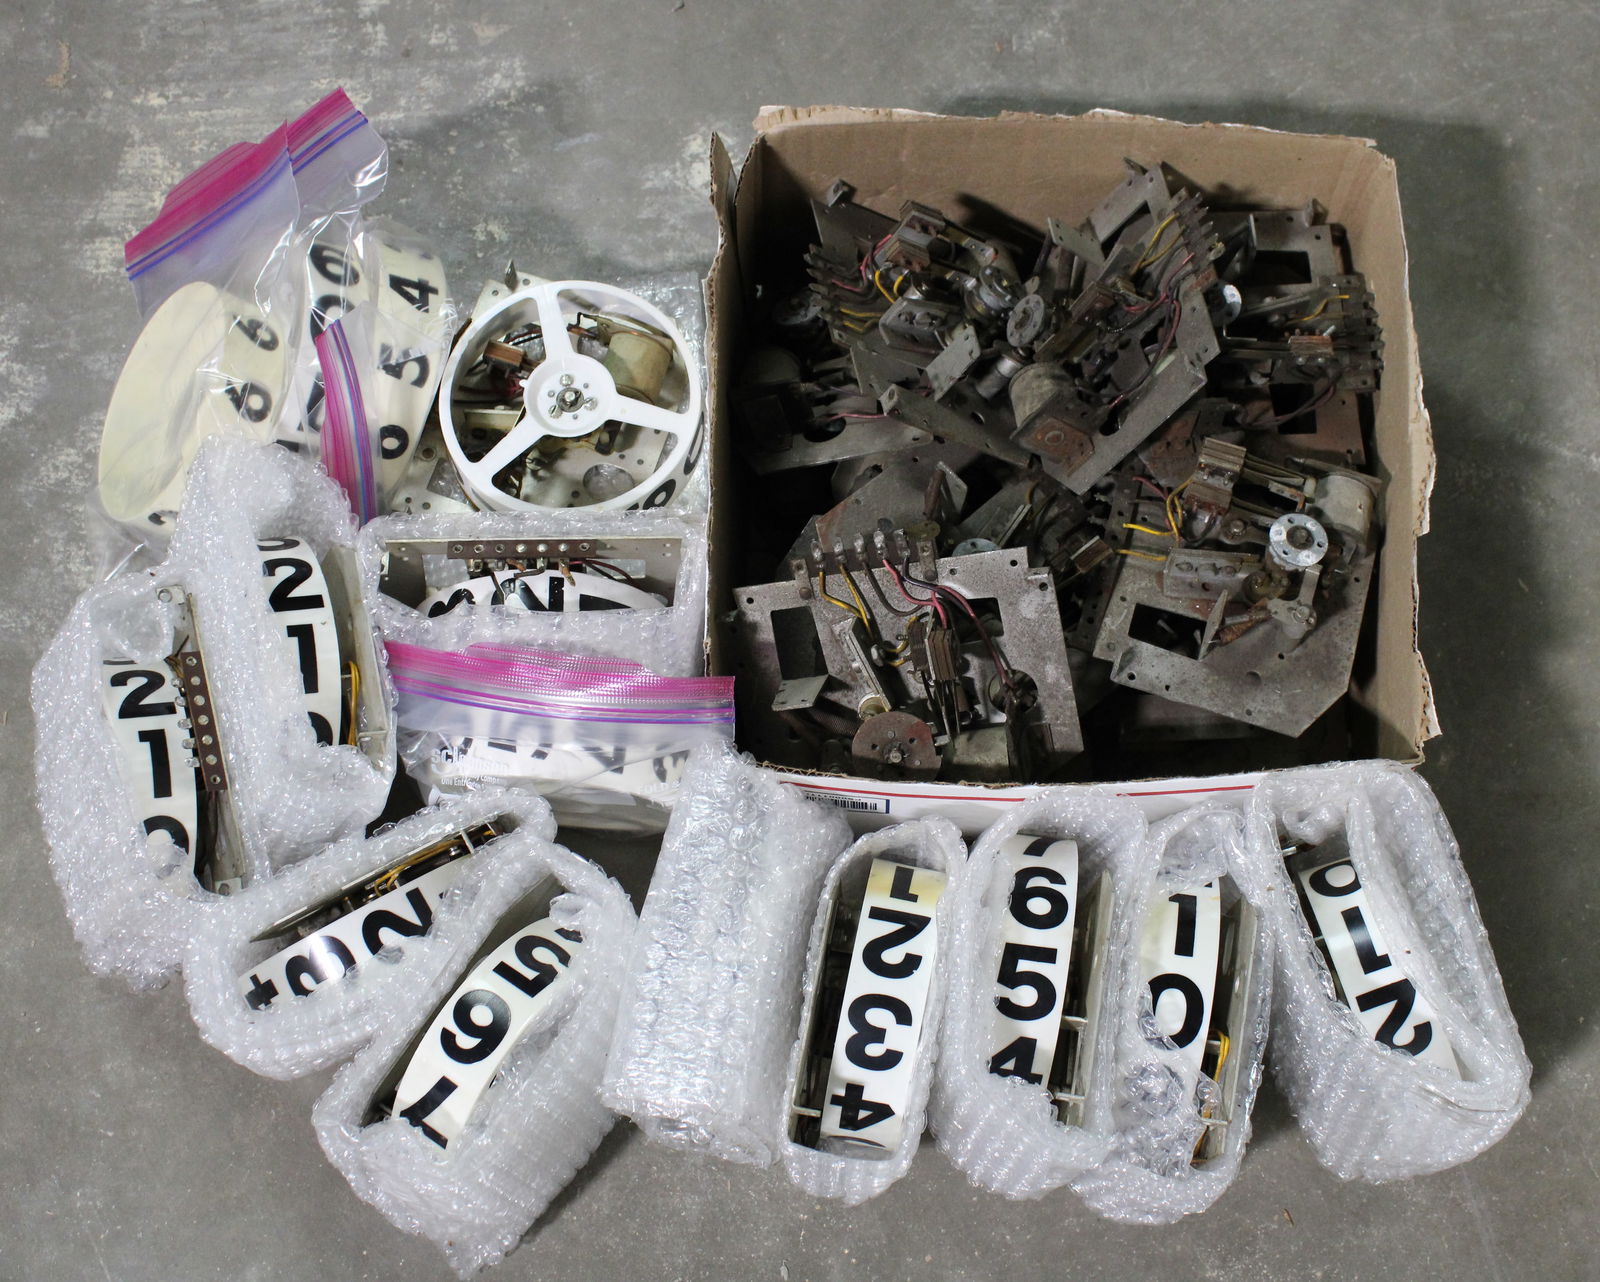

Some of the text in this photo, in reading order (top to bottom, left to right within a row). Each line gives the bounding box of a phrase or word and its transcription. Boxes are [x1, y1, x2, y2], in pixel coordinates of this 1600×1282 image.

[262, 557, 325, 613] 2
[286, 623, 319, 695] 1
[109, 669, 177, 720] 2
[137, 728, 173, 799] 1
[362, 887, 433, 957] 2
[1009, 866, 1069, 930] 6
[1168, 893, 1198, 958] 1
[492, 935, 572, 998] 5
[861, 905, 932, 980] 2
[1341, 905, 1393, 976] 1
[996, 942, 1057, 1022] 5
[844, 993, 913, 1072] 3
[1355, 978, 1434, 1058] 2
[830, 1082, 896, 1132] 4
